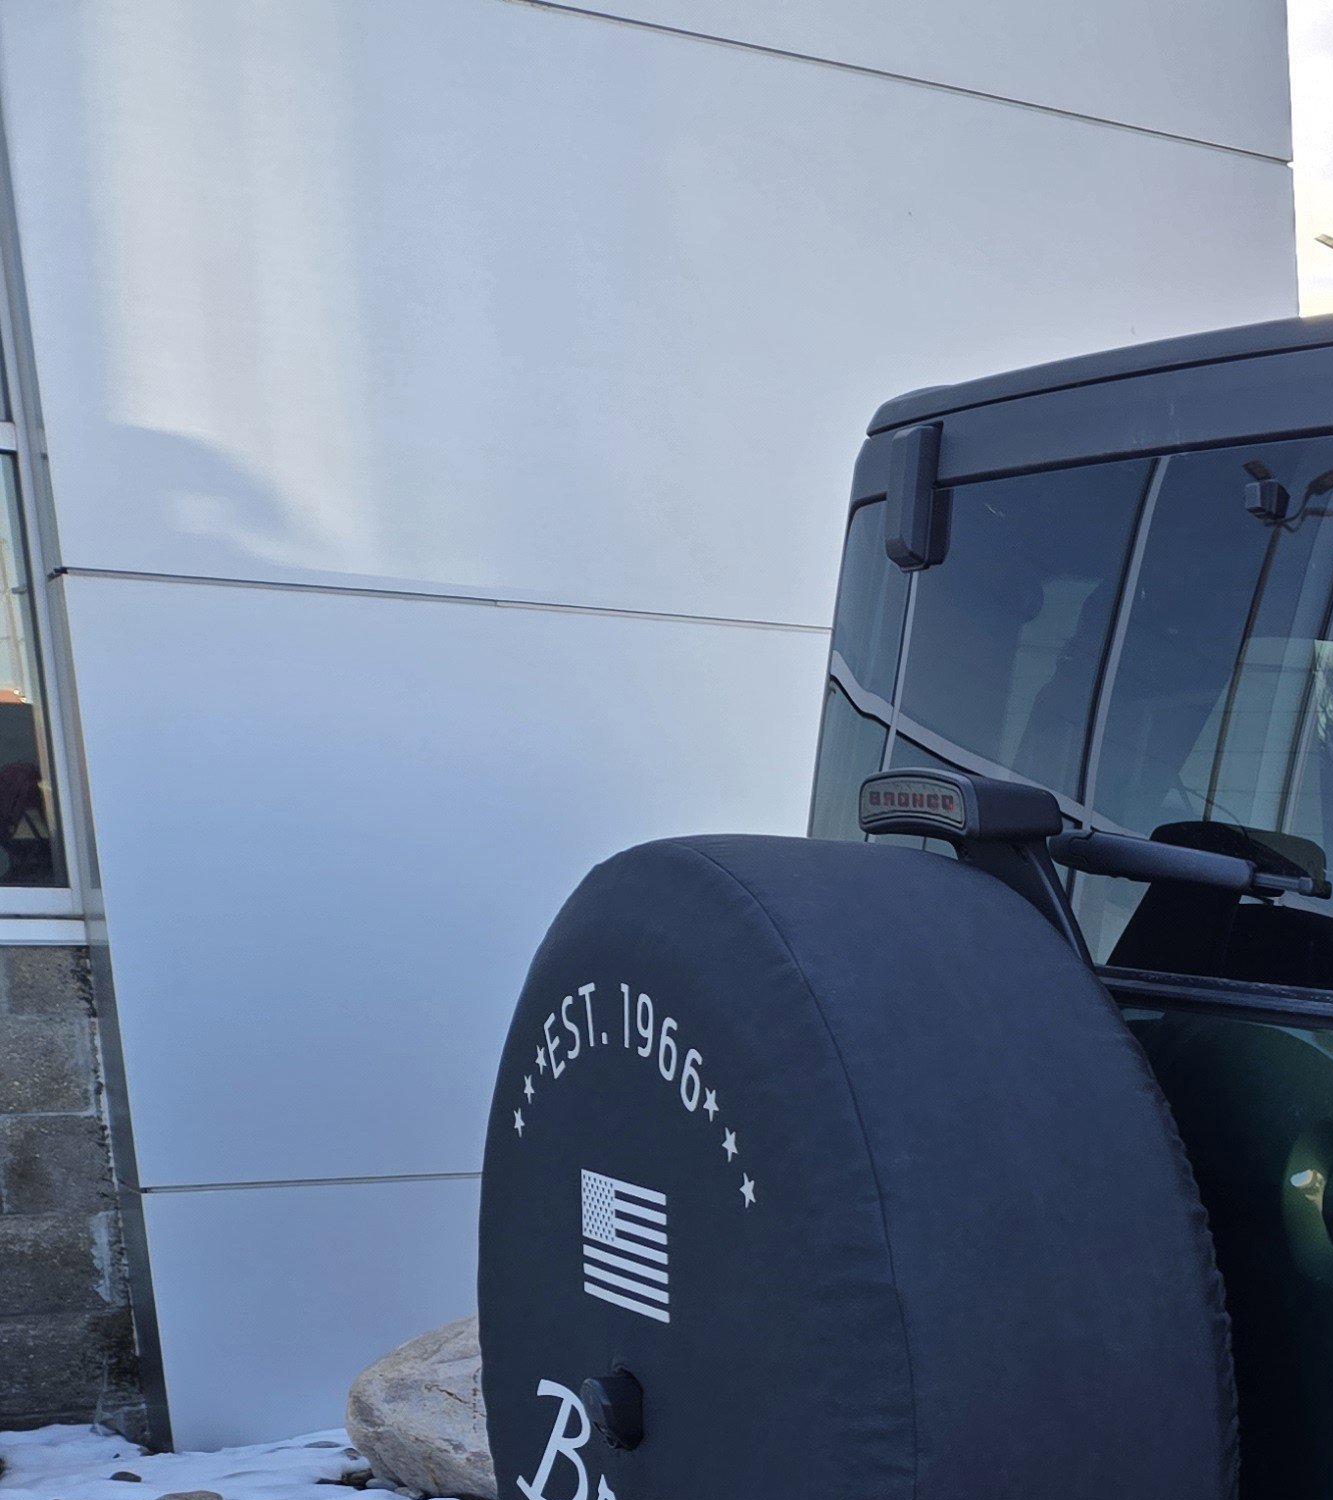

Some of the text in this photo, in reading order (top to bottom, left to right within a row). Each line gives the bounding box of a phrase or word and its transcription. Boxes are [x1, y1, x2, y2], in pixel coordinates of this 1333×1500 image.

[868, 790, 954, 810] BRONCO
[543, 982, 703, 1112] EST. 1966
